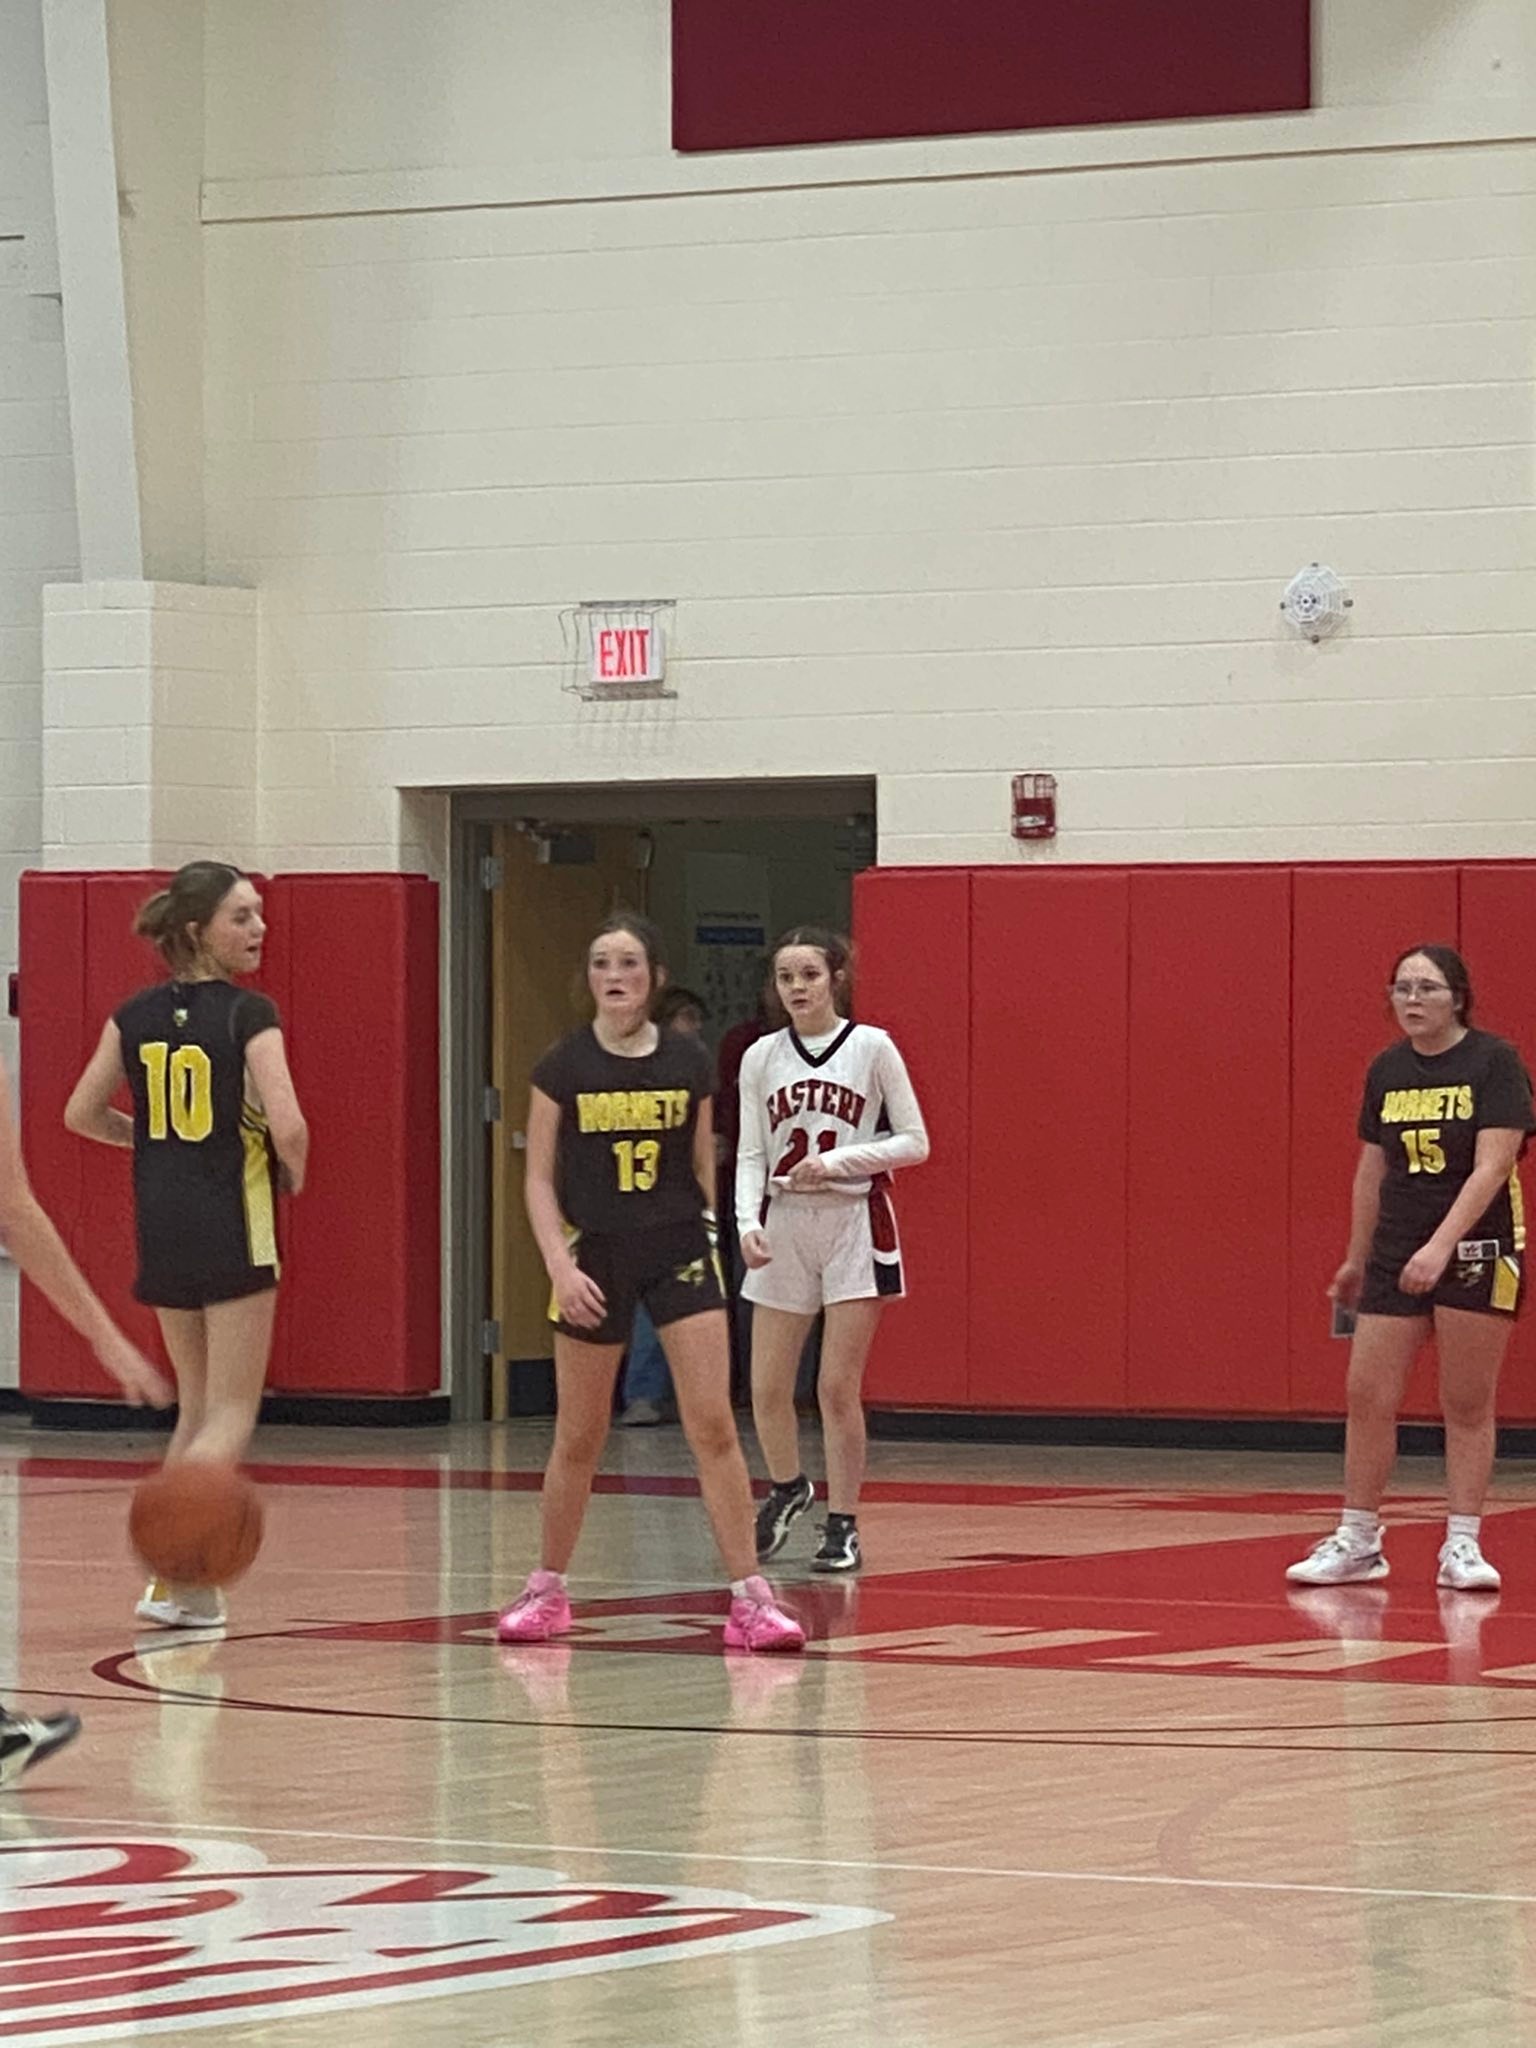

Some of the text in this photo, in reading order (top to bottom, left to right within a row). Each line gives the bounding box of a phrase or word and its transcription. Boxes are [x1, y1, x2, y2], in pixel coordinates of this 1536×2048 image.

[600, 629, 650, 677] EXIT
[139, 1041, 213, 1141] 10
[767, 1078, 866, 1134] EASTERN
[612, 1139, 661, 1192] 13
[1401, 1128, 1446, 1174] 15
